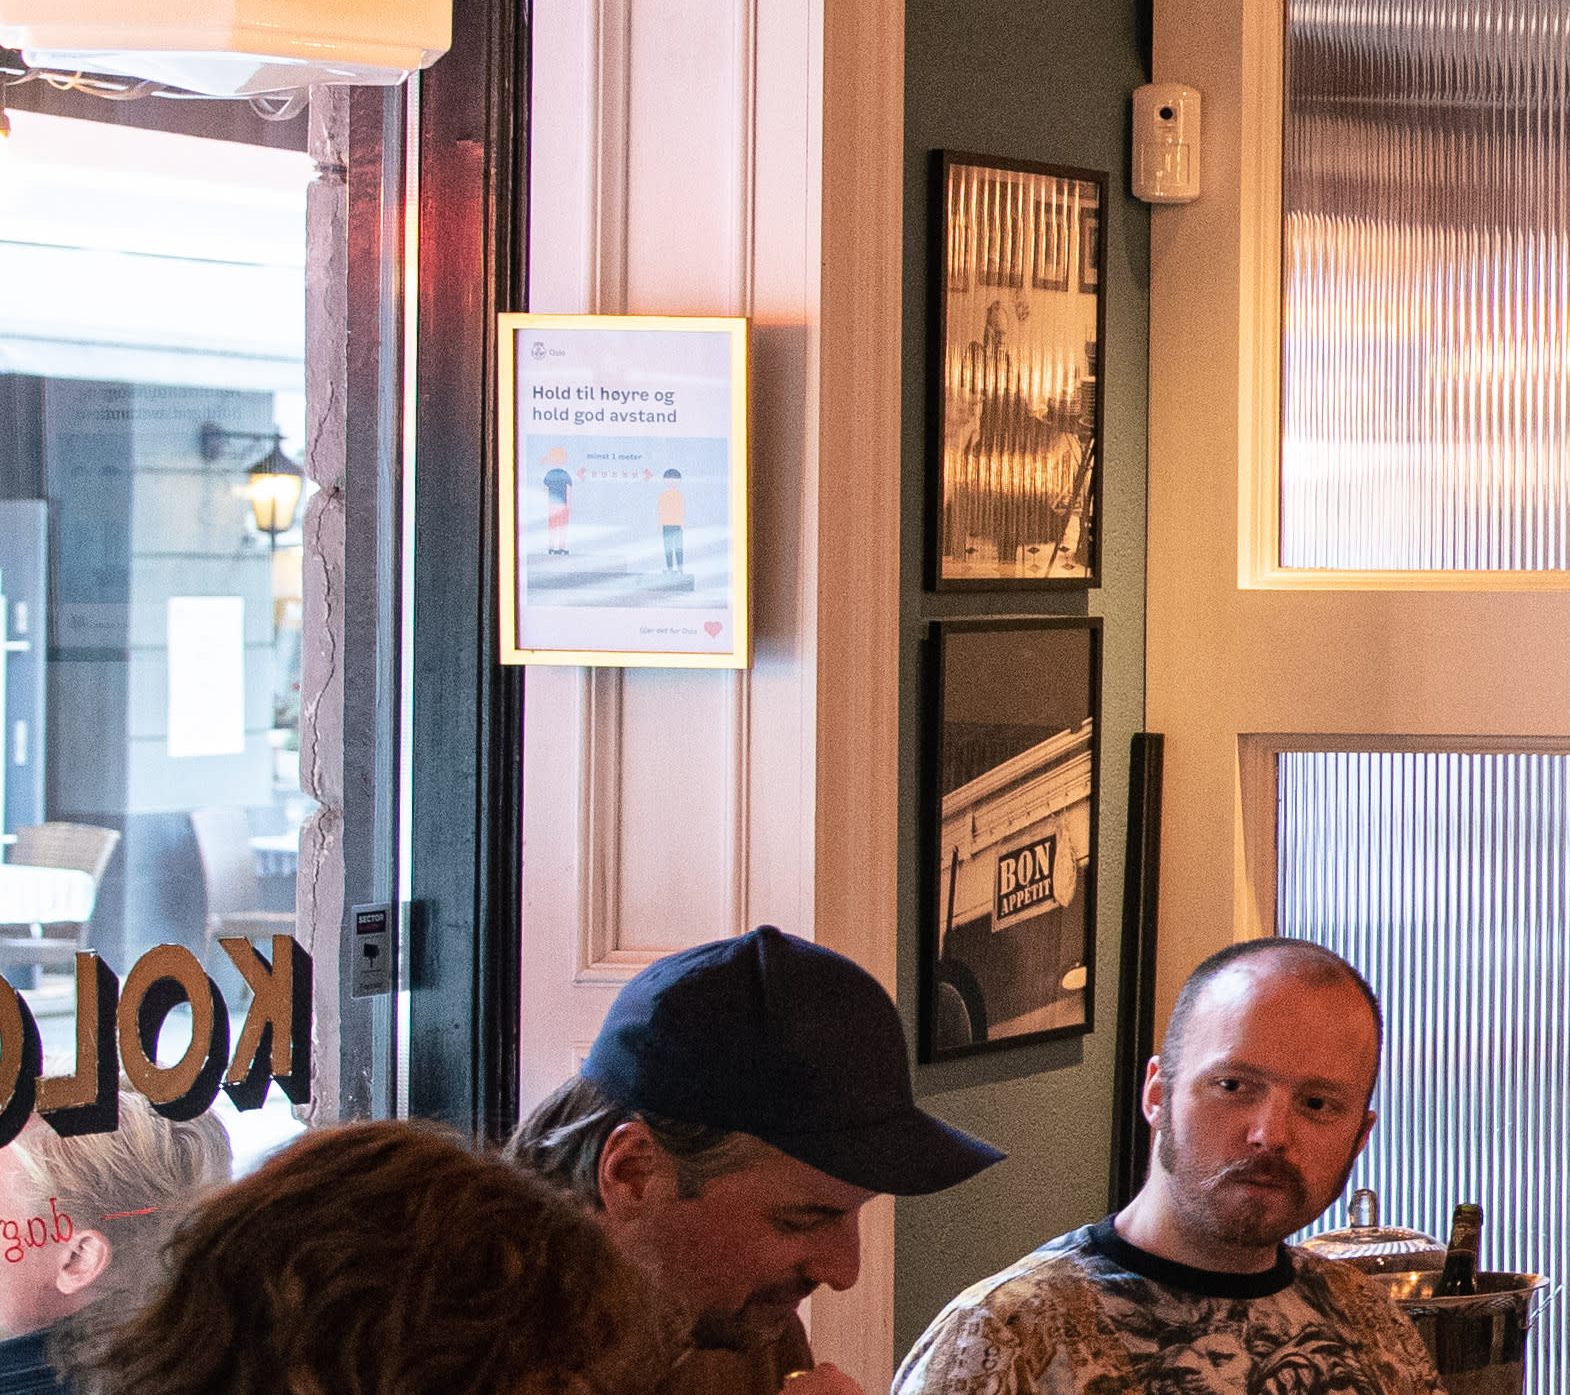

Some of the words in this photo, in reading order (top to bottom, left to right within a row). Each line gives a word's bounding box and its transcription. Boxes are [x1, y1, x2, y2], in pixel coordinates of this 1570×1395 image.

[532, 386, 570, 402] Hold
[576, 385, 596, 402] til
[600, 386, 650, 406] høyre
[653, 389, 676, 406] og
[532, 407, 569, 422] hold
[573, 407, 606, 426] god
[609, 408, 678, 425] avstand
[586, 451, 610, 461] minst
[618, 452, 643, 461] meter
[1000, 842, 1051, 895] BON
[358, 912, 386, 924] SECTOR
